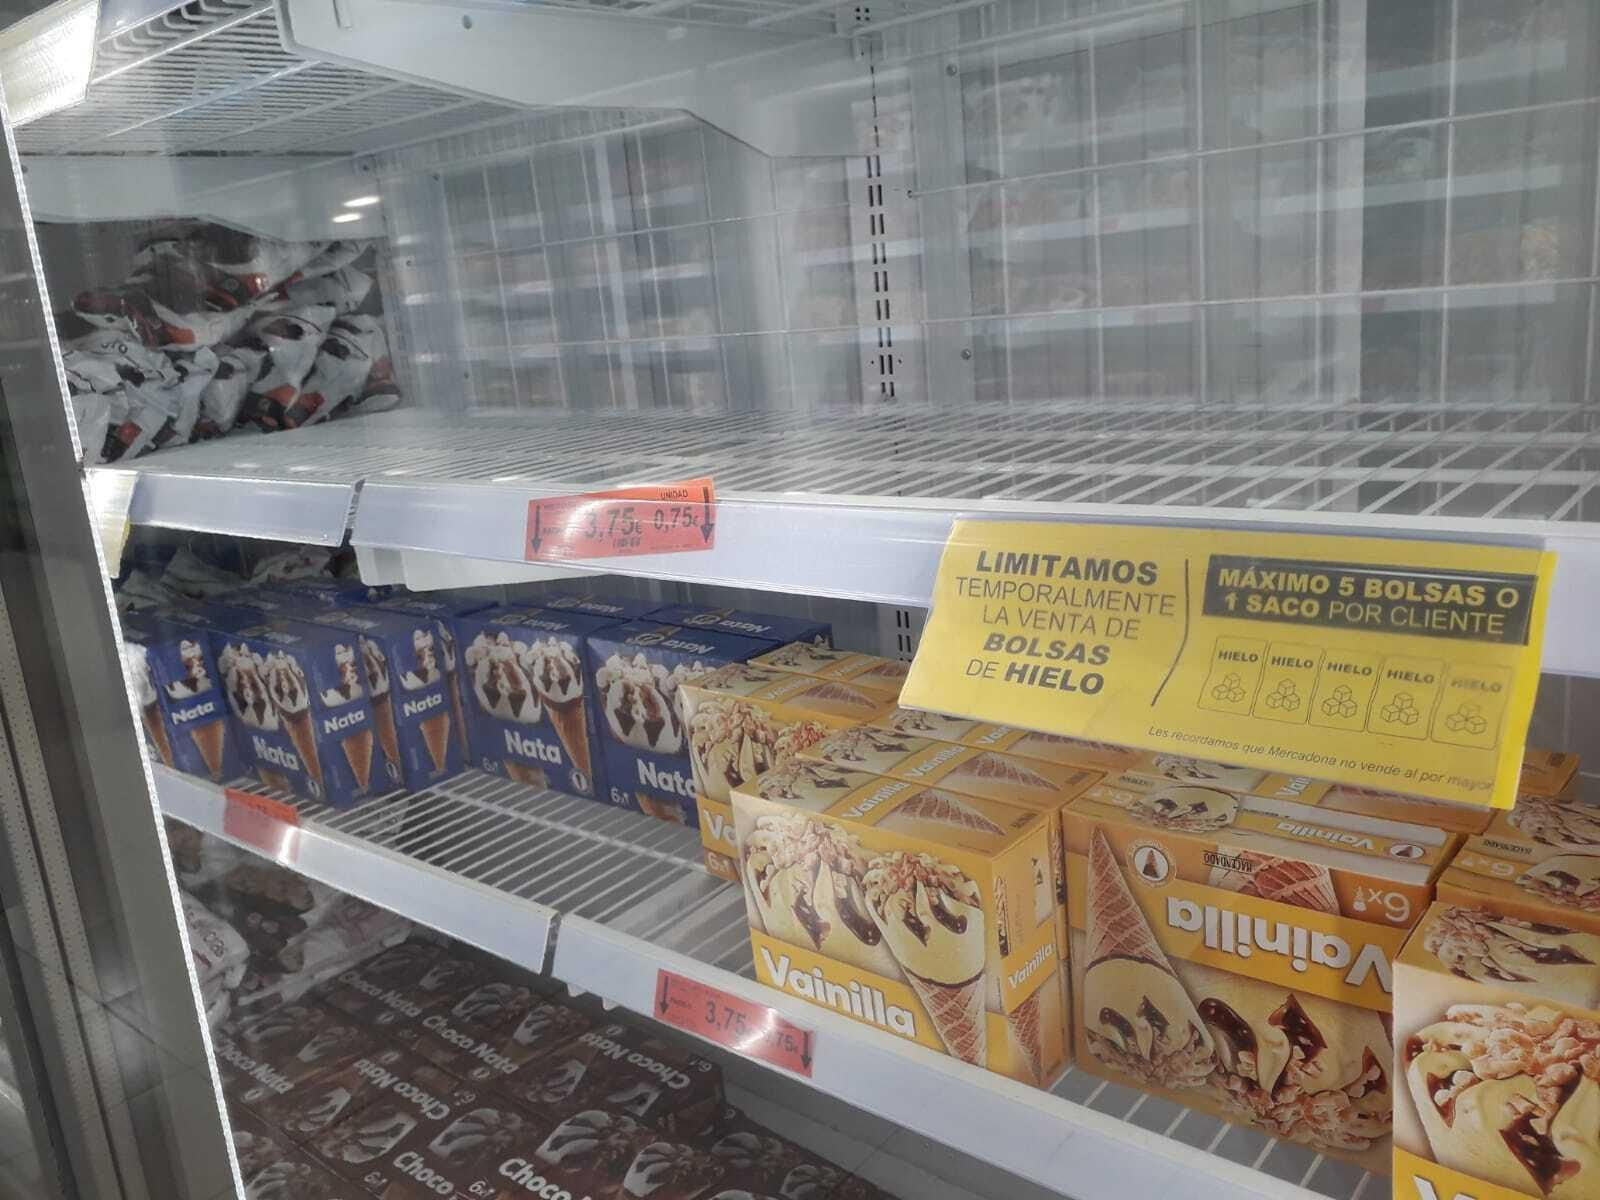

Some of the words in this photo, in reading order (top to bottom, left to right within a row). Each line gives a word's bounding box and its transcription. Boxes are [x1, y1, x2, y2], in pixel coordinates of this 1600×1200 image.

[660, 488, 689, 500] UNIDAD
[654, 506, 699, 533] 0,75€
[976, 550, 1158, 586] LIMITAMOS
[956, 576, 1177, 616] TEMPORALMENTE
[1218, 566, 1330, 594] MÁXIMO
[1339, 576, 1355, 597] 5
[1364, 578, 1486, 607] BOLSAS
[1496, 587, 1519, 609] O
[983, 605, 1009, 626] LA
[1017, 608, 1096, 635] VENTA
[1105, 617, 1142, 640] DE
[1224, 592, 1236, 611] 1
[1246, 594, 1320, 618] SACO
[1328, 601, 1384, 625] POR
[1390, 606, 1505, 635] CLIENTE
[983, 632, 1111, 666] BOLSAS
[1218, 649, 1259, 663] HIELO
[1271, 654, 1314, 670] HIELO
[966, 658, 1000, 679] DE
[1004, 661, 1104, 695] HIELO
[1327, 661, 1372, 677] HIELO
[1387, 668, 1434, 684] HIELO
[1451, 676, 1503, 694] HIELO
[171, 701, 216, 726] Nata
[324, 709, 366, 734] Nata
[403, 693, 443, 717] Nata
[253, 735, 300, 771] Nata
[503, 729, 562, 765] Nata
[1148, 725, 1169, 738] Les
[1171, 730, 1240, 752] recordamos
[1242, 742, 1266, 758] que
[1268, 745, 1337, 767] Mercadona
[1340, 758, 1357, 769] no
[1360, 759, 1401, 777] vende
[1404, 766, 1417, 780] al
[1419, 770, 1444, 786] por
[1447, 775, 1495, 791] mayor
[1276, 821, 1375, 850] Vainilla
[1167, 896, 1393, 993] Vainilla
[1008, 943, 1055, 989] Vainilla
[760, 945, 917, 1038] Vainilla
[469, 1042, 519, 1074] Nata
[579, 1032, 630, 1060] Nata
[627, 1052, 691, 1090] Choco
[393, 1081, 450, 1120] Choco
[393, 1151, 455, 1195] Choco
[498, 1157, 573, 1200] Choco
